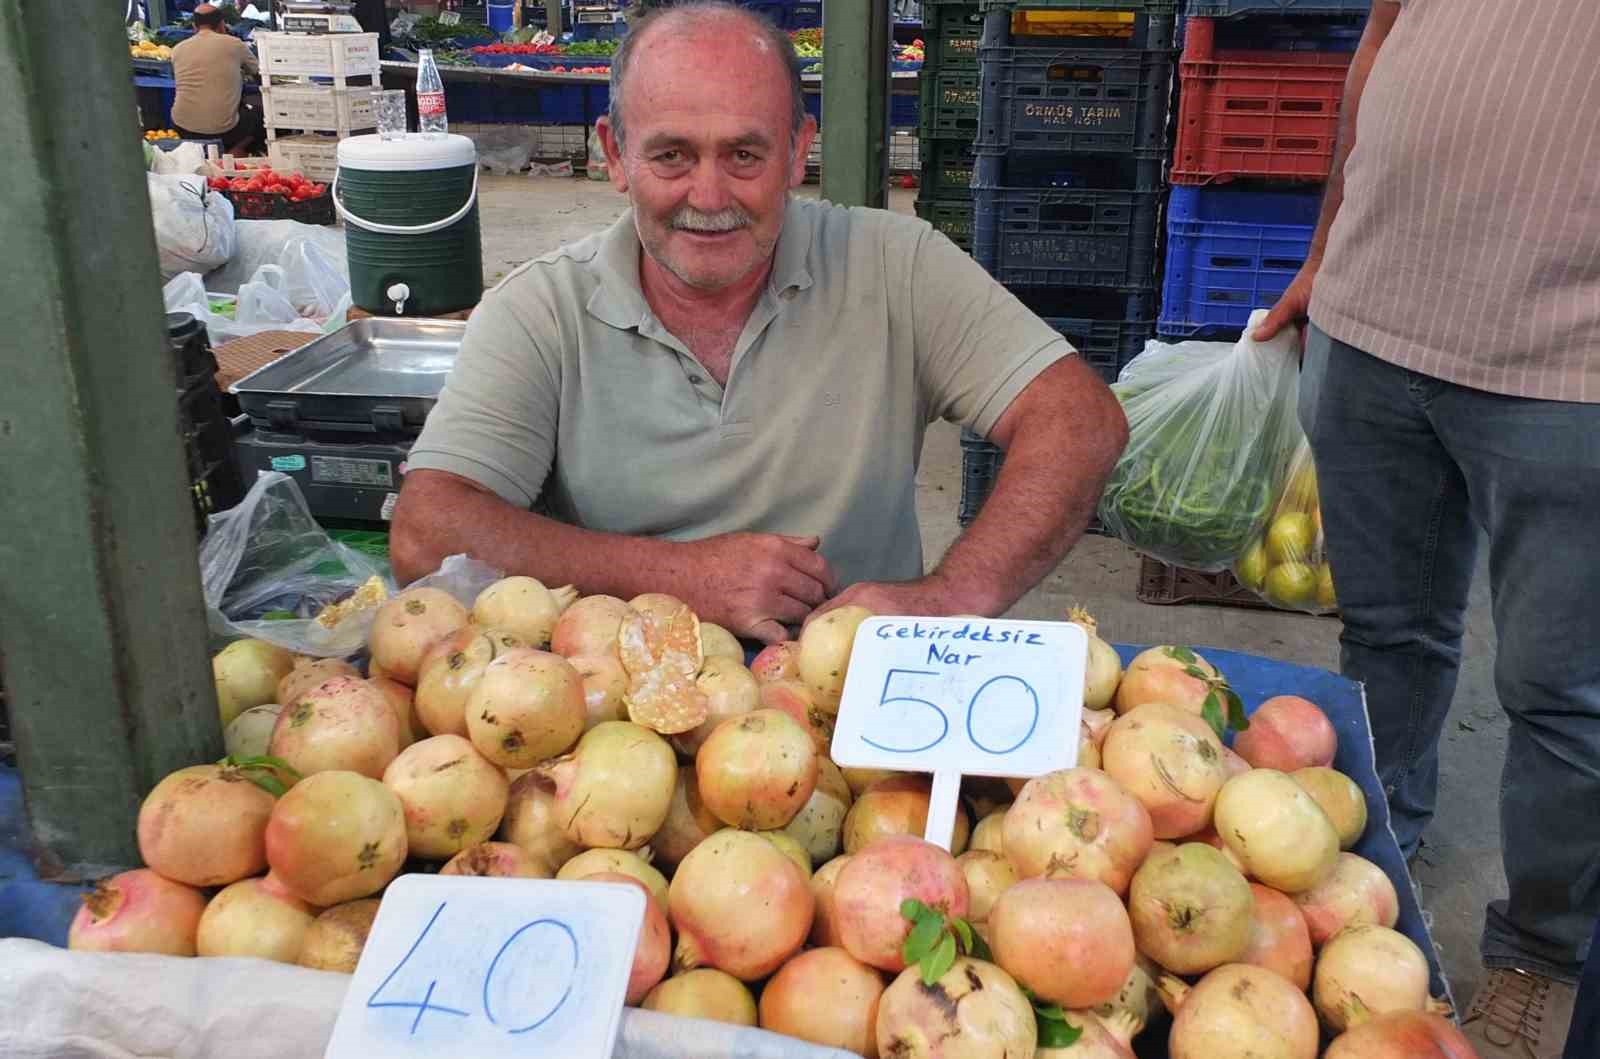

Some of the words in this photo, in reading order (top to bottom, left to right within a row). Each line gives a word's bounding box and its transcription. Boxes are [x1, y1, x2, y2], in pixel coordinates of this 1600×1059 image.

[1080, 106, 1121, 118] TARIM
[876, 622, 1046, 646] Çekirdeksiz
[926, 643, 982, 666] Nar
[860, 668, 1040, 756] 50
[367, 901, 579, 1034] 40
